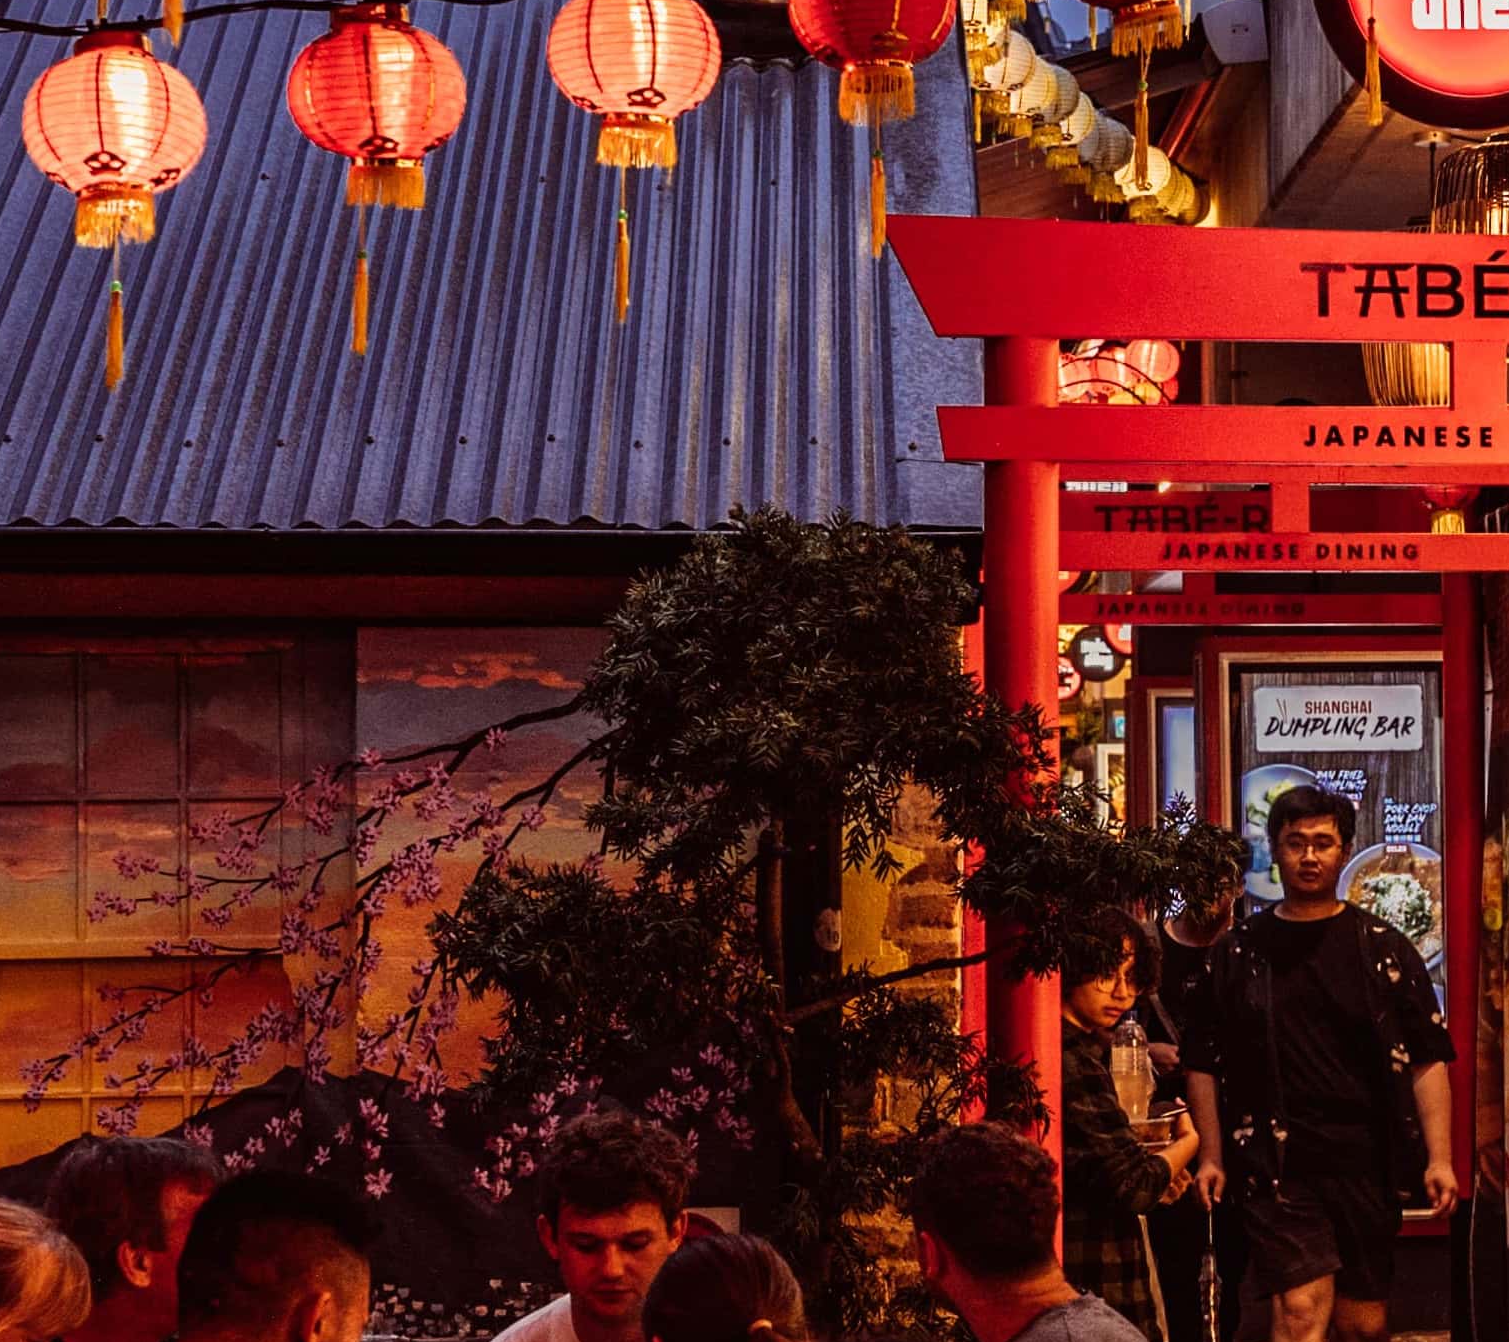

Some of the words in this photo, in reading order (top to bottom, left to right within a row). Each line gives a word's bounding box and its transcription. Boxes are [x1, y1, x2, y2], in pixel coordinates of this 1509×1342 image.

[1304, 425, 1494, 449] JAPANESE
[1095, 496, 1270, 533] TABÉ-R
[1162, 542, 1300, 560] JAPANESE
[1316, 543, 1420, 561] DINING
[1304, 700, 1372, 715] SHANGHAI
[1265, 716, 1368, 741] DUMPLING
[1370, 716, 1415, 739] BAR
